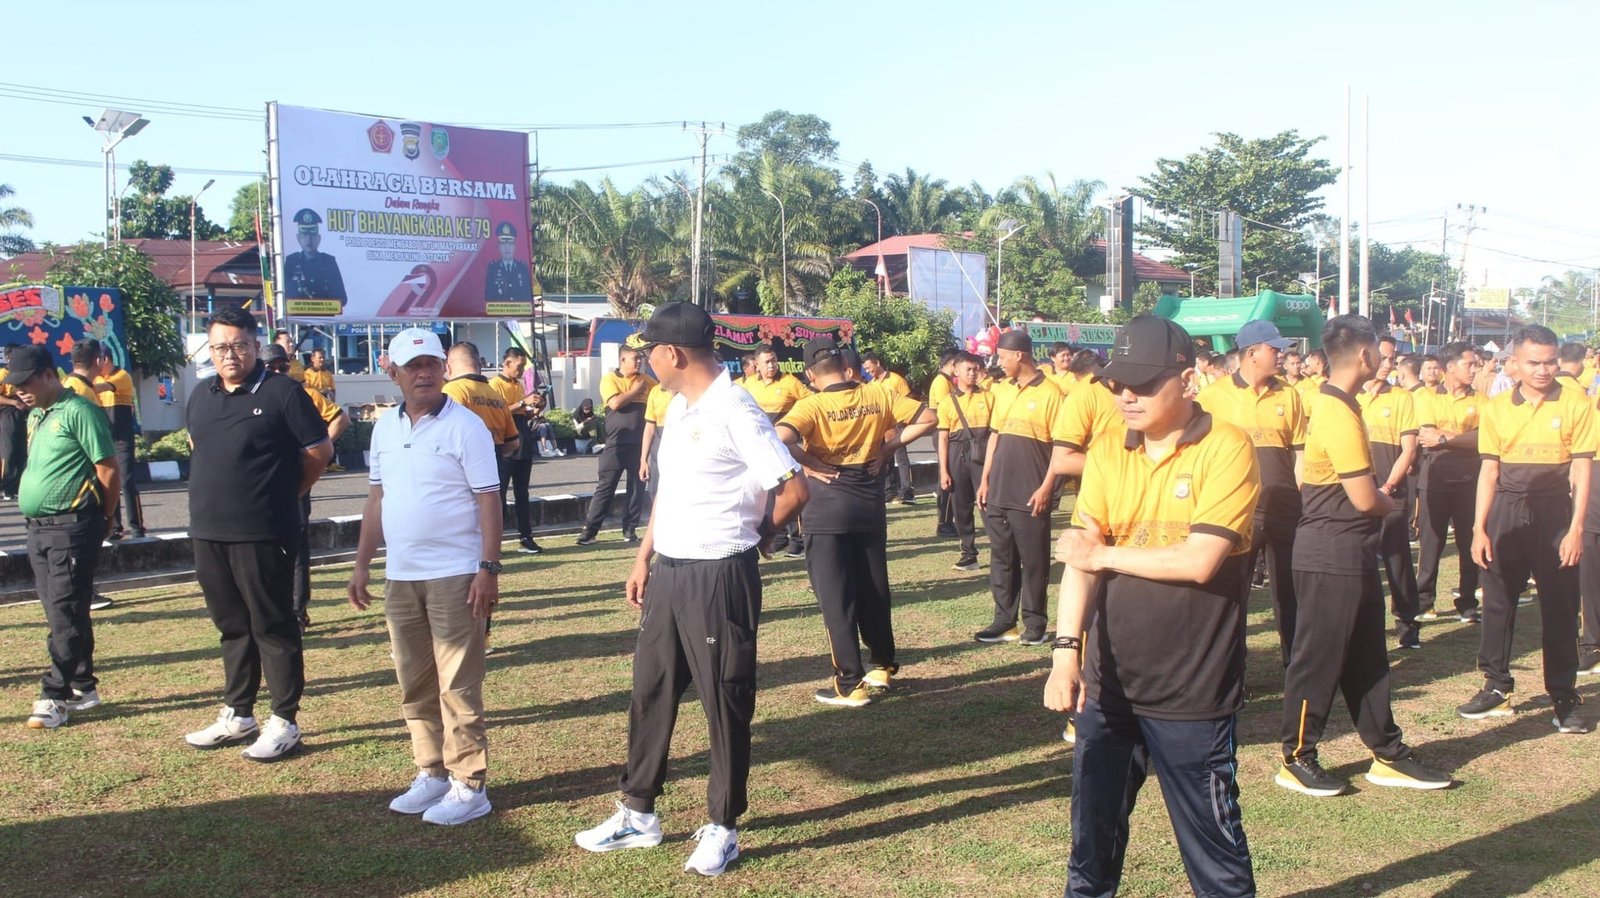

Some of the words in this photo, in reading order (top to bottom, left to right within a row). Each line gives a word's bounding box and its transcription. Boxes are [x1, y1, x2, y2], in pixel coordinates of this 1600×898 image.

[294, 165, 416, 194] OLAHRAGA
[419, 176, 517, 201] BERSAMA
[384, 197, 411, 209] Dalam
[412, 198, 440, 214] Rangka
[327, 208, 354, 233] HUT
[357, 210, 455, 238] BHAYANGKARA
[455, 216, 473, 239] KE
[474, 217, 491, 240] 79
[439, 241, 478, 252] MASYARAKAT
[714, 325, 754, 344] ELAMAT
[827, 409, 847, 422] POLDA
[849, 402, 881, 419] BENGKULU
